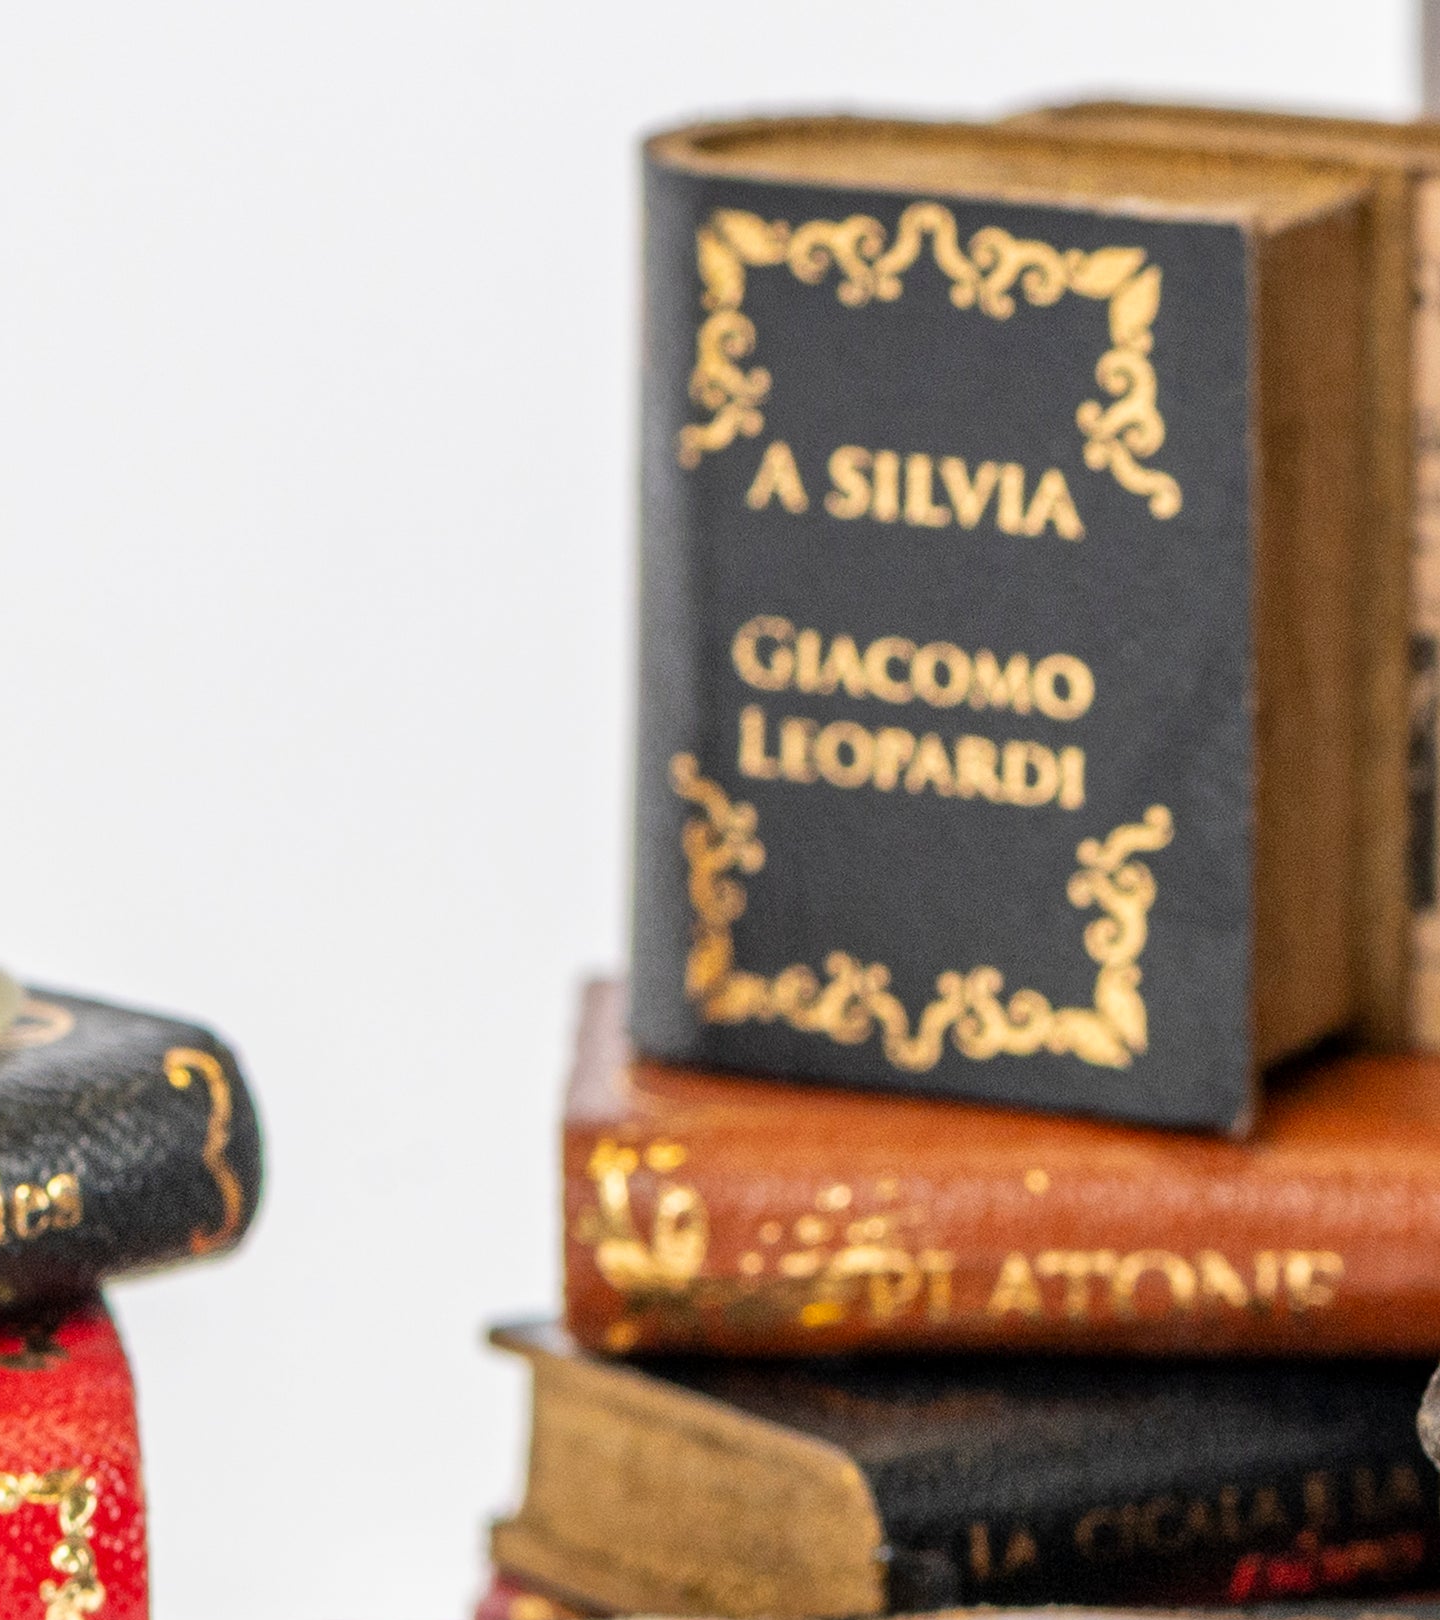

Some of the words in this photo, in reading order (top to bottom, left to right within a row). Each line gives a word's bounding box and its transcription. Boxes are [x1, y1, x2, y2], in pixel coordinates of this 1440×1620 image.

[747, 442, 808, 512] A
[826, 445, 1083, 540] SILVIA
[733, 615, 1094, 720] GIACOMO
[738, 704, 1085, 808] LEOPARDI
